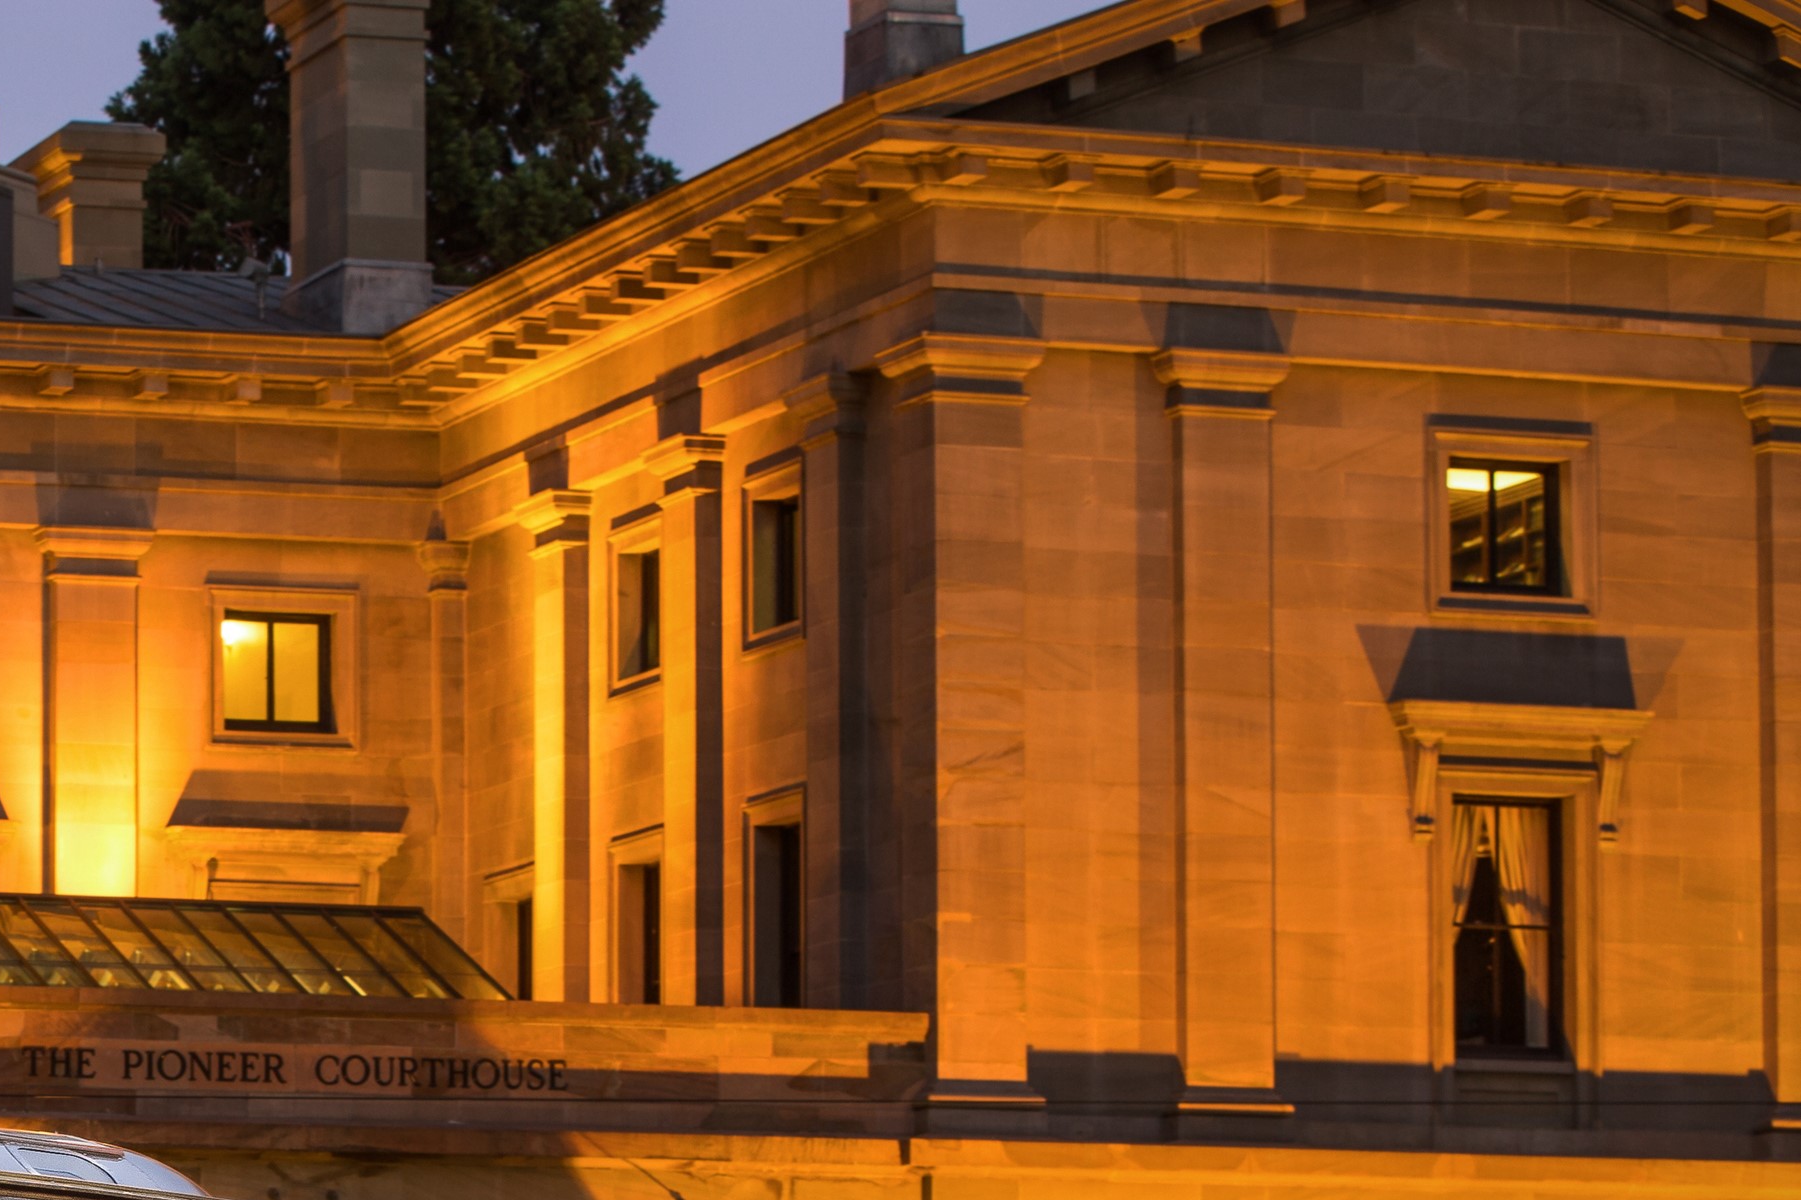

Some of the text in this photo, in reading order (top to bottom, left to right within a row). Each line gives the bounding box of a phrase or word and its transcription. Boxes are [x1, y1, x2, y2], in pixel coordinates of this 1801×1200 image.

[21, 1046, 569, 1092] THE PIONEER COURTHOUSE
